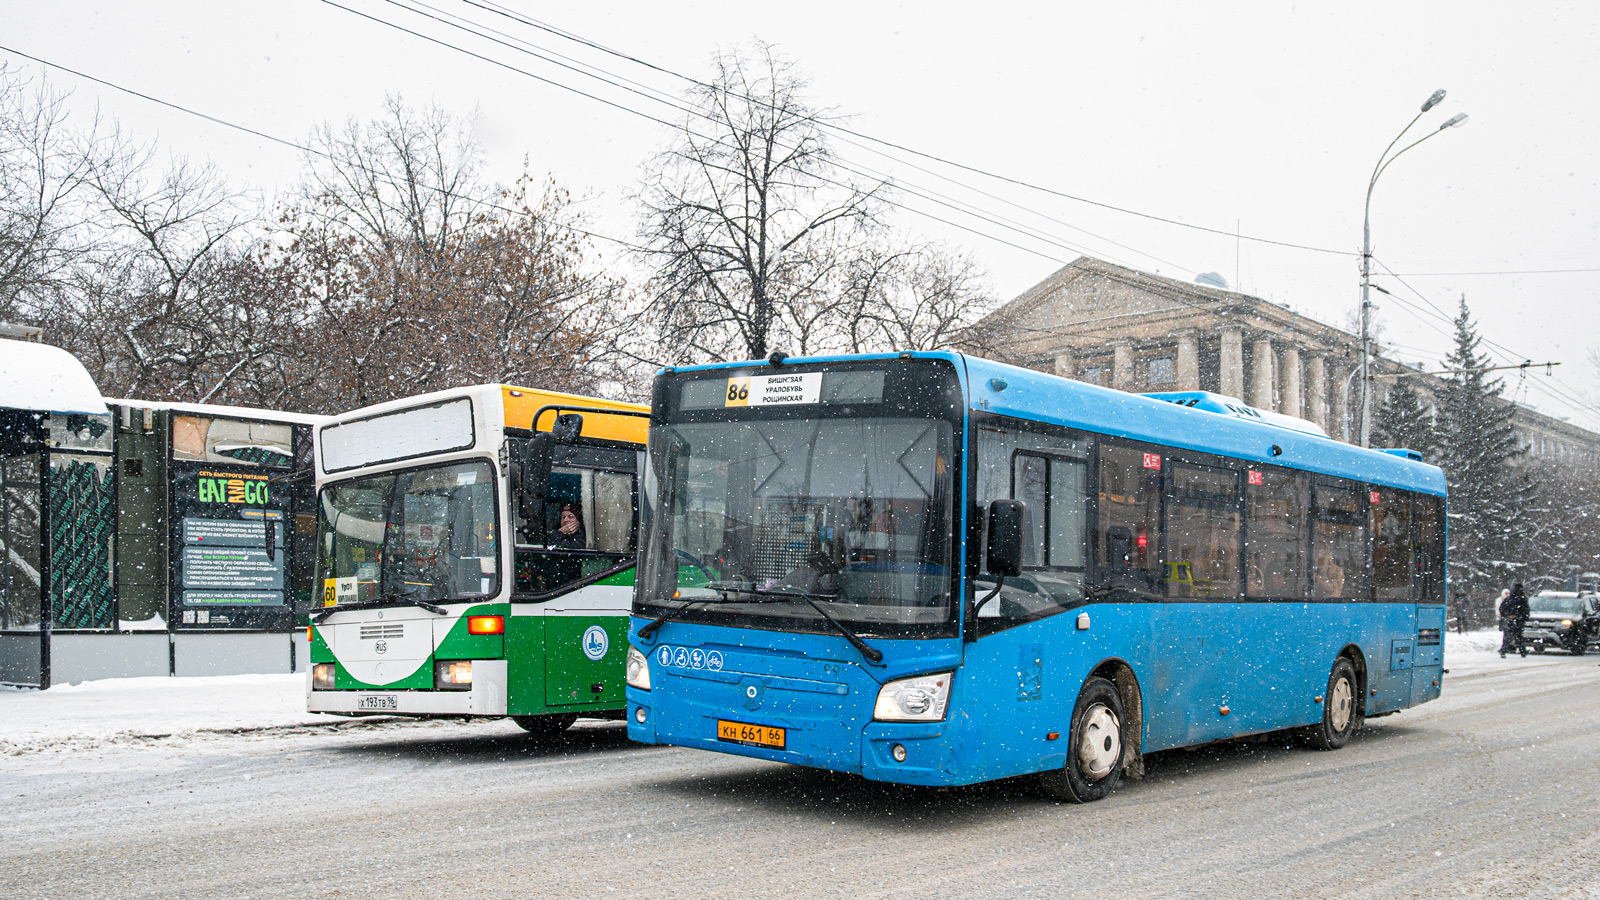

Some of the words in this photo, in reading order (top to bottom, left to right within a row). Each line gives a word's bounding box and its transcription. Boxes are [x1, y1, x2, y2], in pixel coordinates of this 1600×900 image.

[728, 383, 748, 401] 86
[199, 479, 228, 503] EAT
[227, 480, 245, 503] AND
[245, 481, 268, 504] GO
[326, 586, 335, 601] 60
[376, 642, 386, 651] RUS
[723, 726, 736, 738] КН
[741, 726, 762, 741] 661
[769, 729, 780, 740] 66
